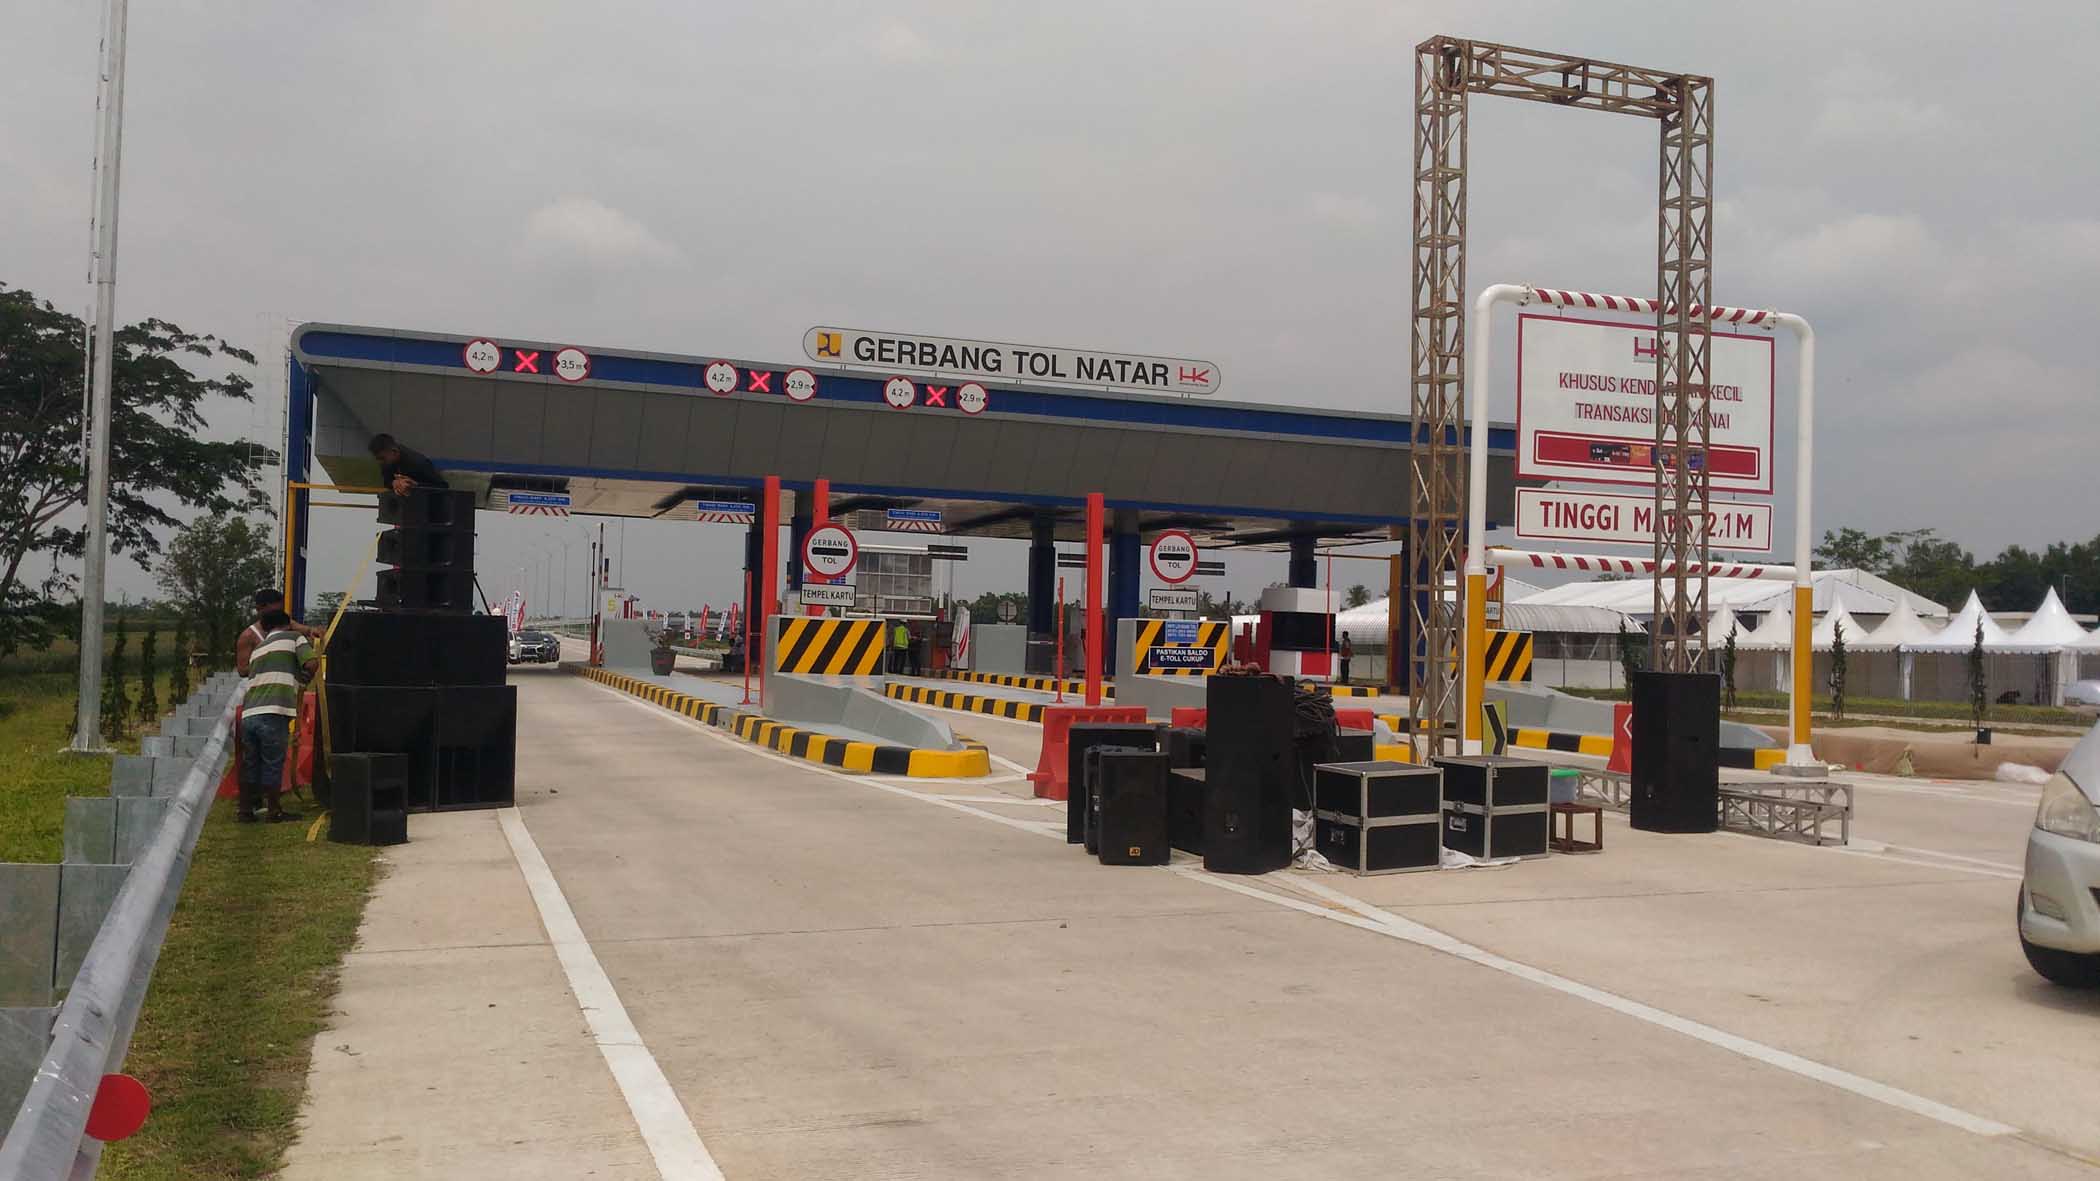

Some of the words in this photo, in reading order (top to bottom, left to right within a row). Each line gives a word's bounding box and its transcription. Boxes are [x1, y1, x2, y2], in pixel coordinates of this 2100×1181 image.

[854, 336, 1002, 372] GERBANG
[1012, 351, 1067, 378] TOL
[1076, 356, 1169, 386] NATAR
[1179, 366, 1209, 383] HK
[1559, 372, 1616, 393] KHUSUS
[1576, 402, 1652, 424] TRANSAKSI
[1540, 501, 1619, 531] TINGGI
[812, 539, 849, 548] GERBANG
[1158, 545, 1190, 553] GERBANG
[823, 556, 837, 565] TOL
[1168, 561, 1182, 569] TOL
[803, 589, 829, 599] TEMPEL
[830, 591, 854, 601] KARTU
[1152, 595, 1175, 604] TEMPEL
[1176, 596, 1196, 606] KARTU
